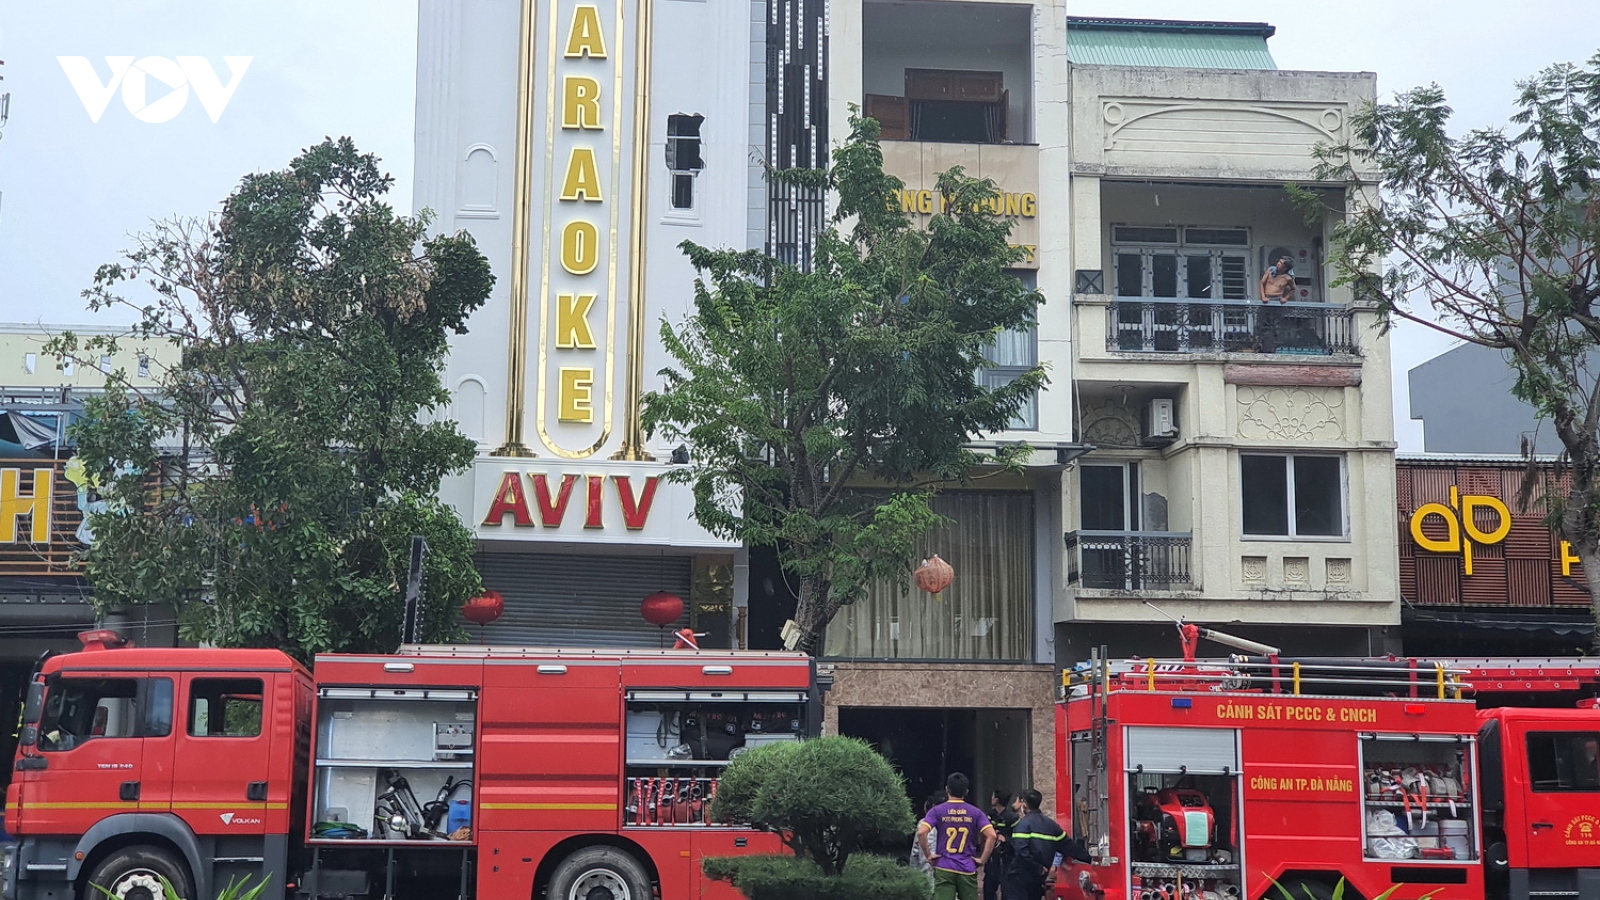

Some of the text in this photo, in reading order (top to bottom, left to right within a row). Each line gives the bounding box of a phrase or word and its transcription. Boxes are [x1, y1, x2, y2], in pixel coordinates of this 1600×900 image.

[480, 471, 663, 530] AVIV
[1216, 700, 1377, 723] CẢNH SÁT PCCC & CNCH
[1250, 774, 1278, 790] CÔNG
[1279, 778, 1294, 791] AN
[946, 827, 969, 853] 27
